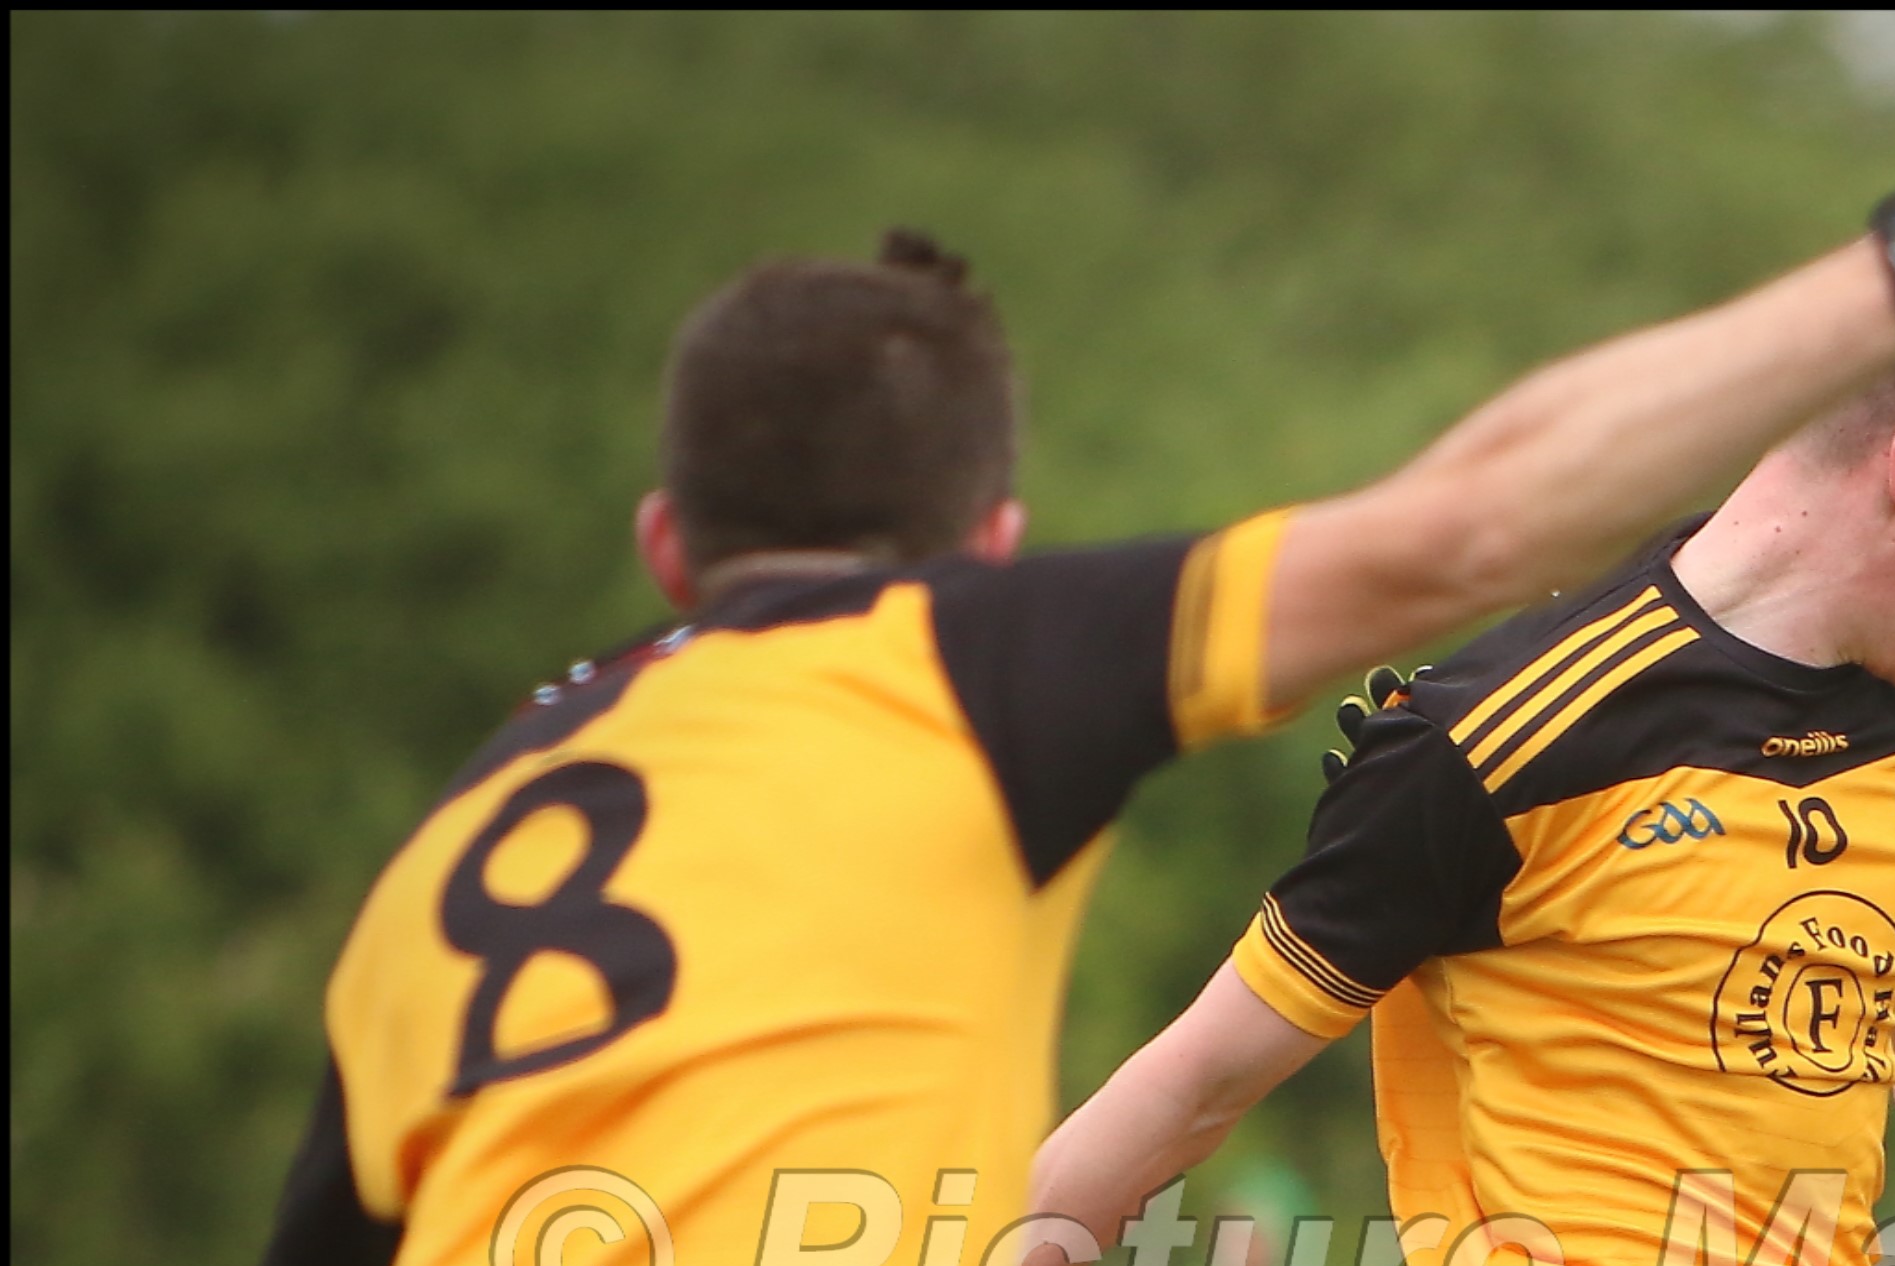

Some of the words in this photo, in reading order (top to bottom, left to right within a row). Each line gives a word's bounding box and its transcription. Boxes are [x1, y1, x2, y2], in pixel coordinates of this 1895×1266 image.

[1778, 796, 1848, 869] 10
[442, 760, 678, 1101] 8
[1799, 917, 1894, 978] Food
[1805, 978, 1843, 1053] F
